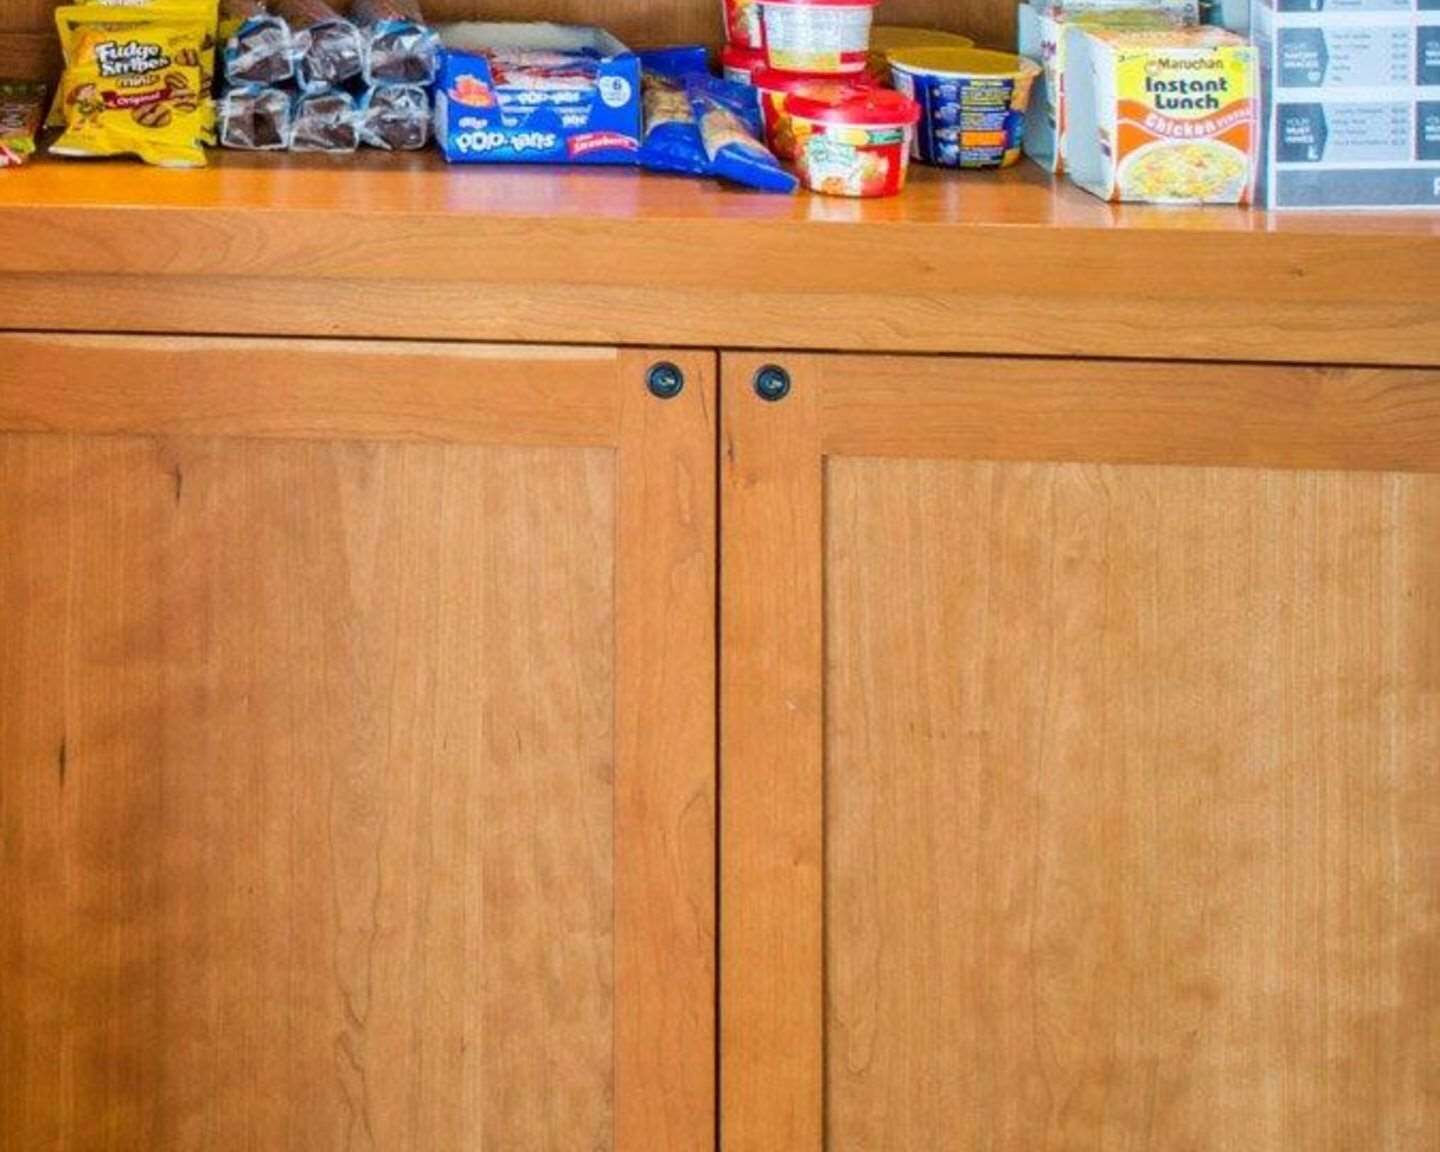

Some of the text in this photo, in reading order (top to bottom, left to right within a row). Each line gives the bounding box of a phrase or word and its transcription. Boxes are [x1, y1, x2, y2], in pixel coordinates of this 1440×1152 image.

[1157, 57, 1225, 71] Maruchan
[1145, 76, 1229, 95] Instant
[1154, 94, 1221, 111] Lunch
